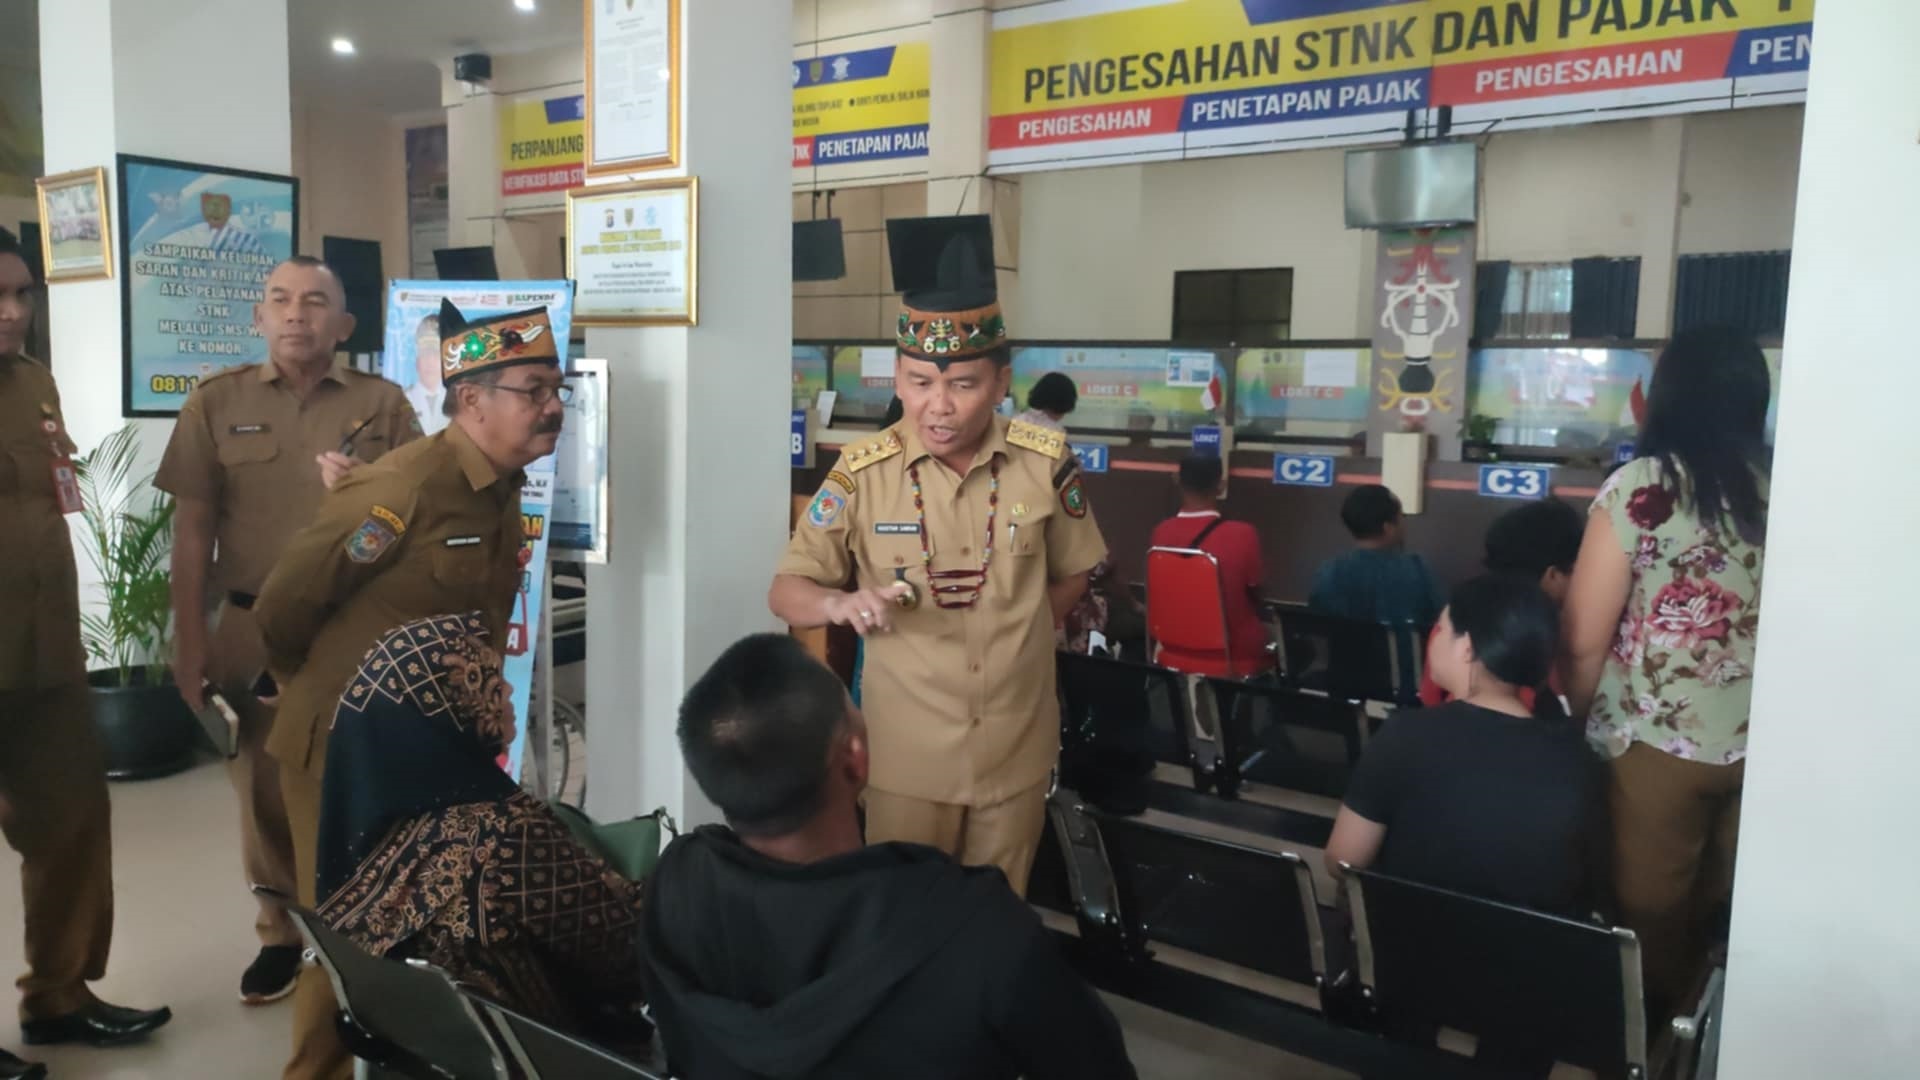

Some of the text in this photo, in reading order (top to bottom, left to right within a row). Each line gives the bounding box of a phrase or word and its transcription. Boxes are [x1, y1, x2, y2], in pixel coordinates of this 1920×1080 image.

[1023, 36, 1280, 103] PENGESAHAN
[1295, 16, 1418, 71] STNK
[1432, 0, 1540, 55] DAN
[1476, 48, 1683, 93] PENGESAHAN
[1192, 78, 1421, 123] PENETAPAN PAJAK
[1018, 108, 1151, 139] PENGESAHAN
[511, 134, 584, 161] PERPANJANG
[818, 136, 891, 158] PENETAPAN
[144, 243, 217, 260] SAMPAIKAN
[136, 261, 178, 277] SARAN
[183, 265, 208, 279] DAN
[160, 282, 264, 302] ATAS PELAYANAN
[198, 304, 231, 318] STNK
[159, 320, 213, 335] MELALUI
[218, 323, 242, 336] SMS
[179, 340, 241, 354] KE NOMOR
[151, 374, 198, 394] 0811
[1086, 383, 1134, 395] LOKET C
[791, 432, 803, 454] B
[1280, 459, 1326, 483] C2
[1487, 470, 1540, 496] C3
